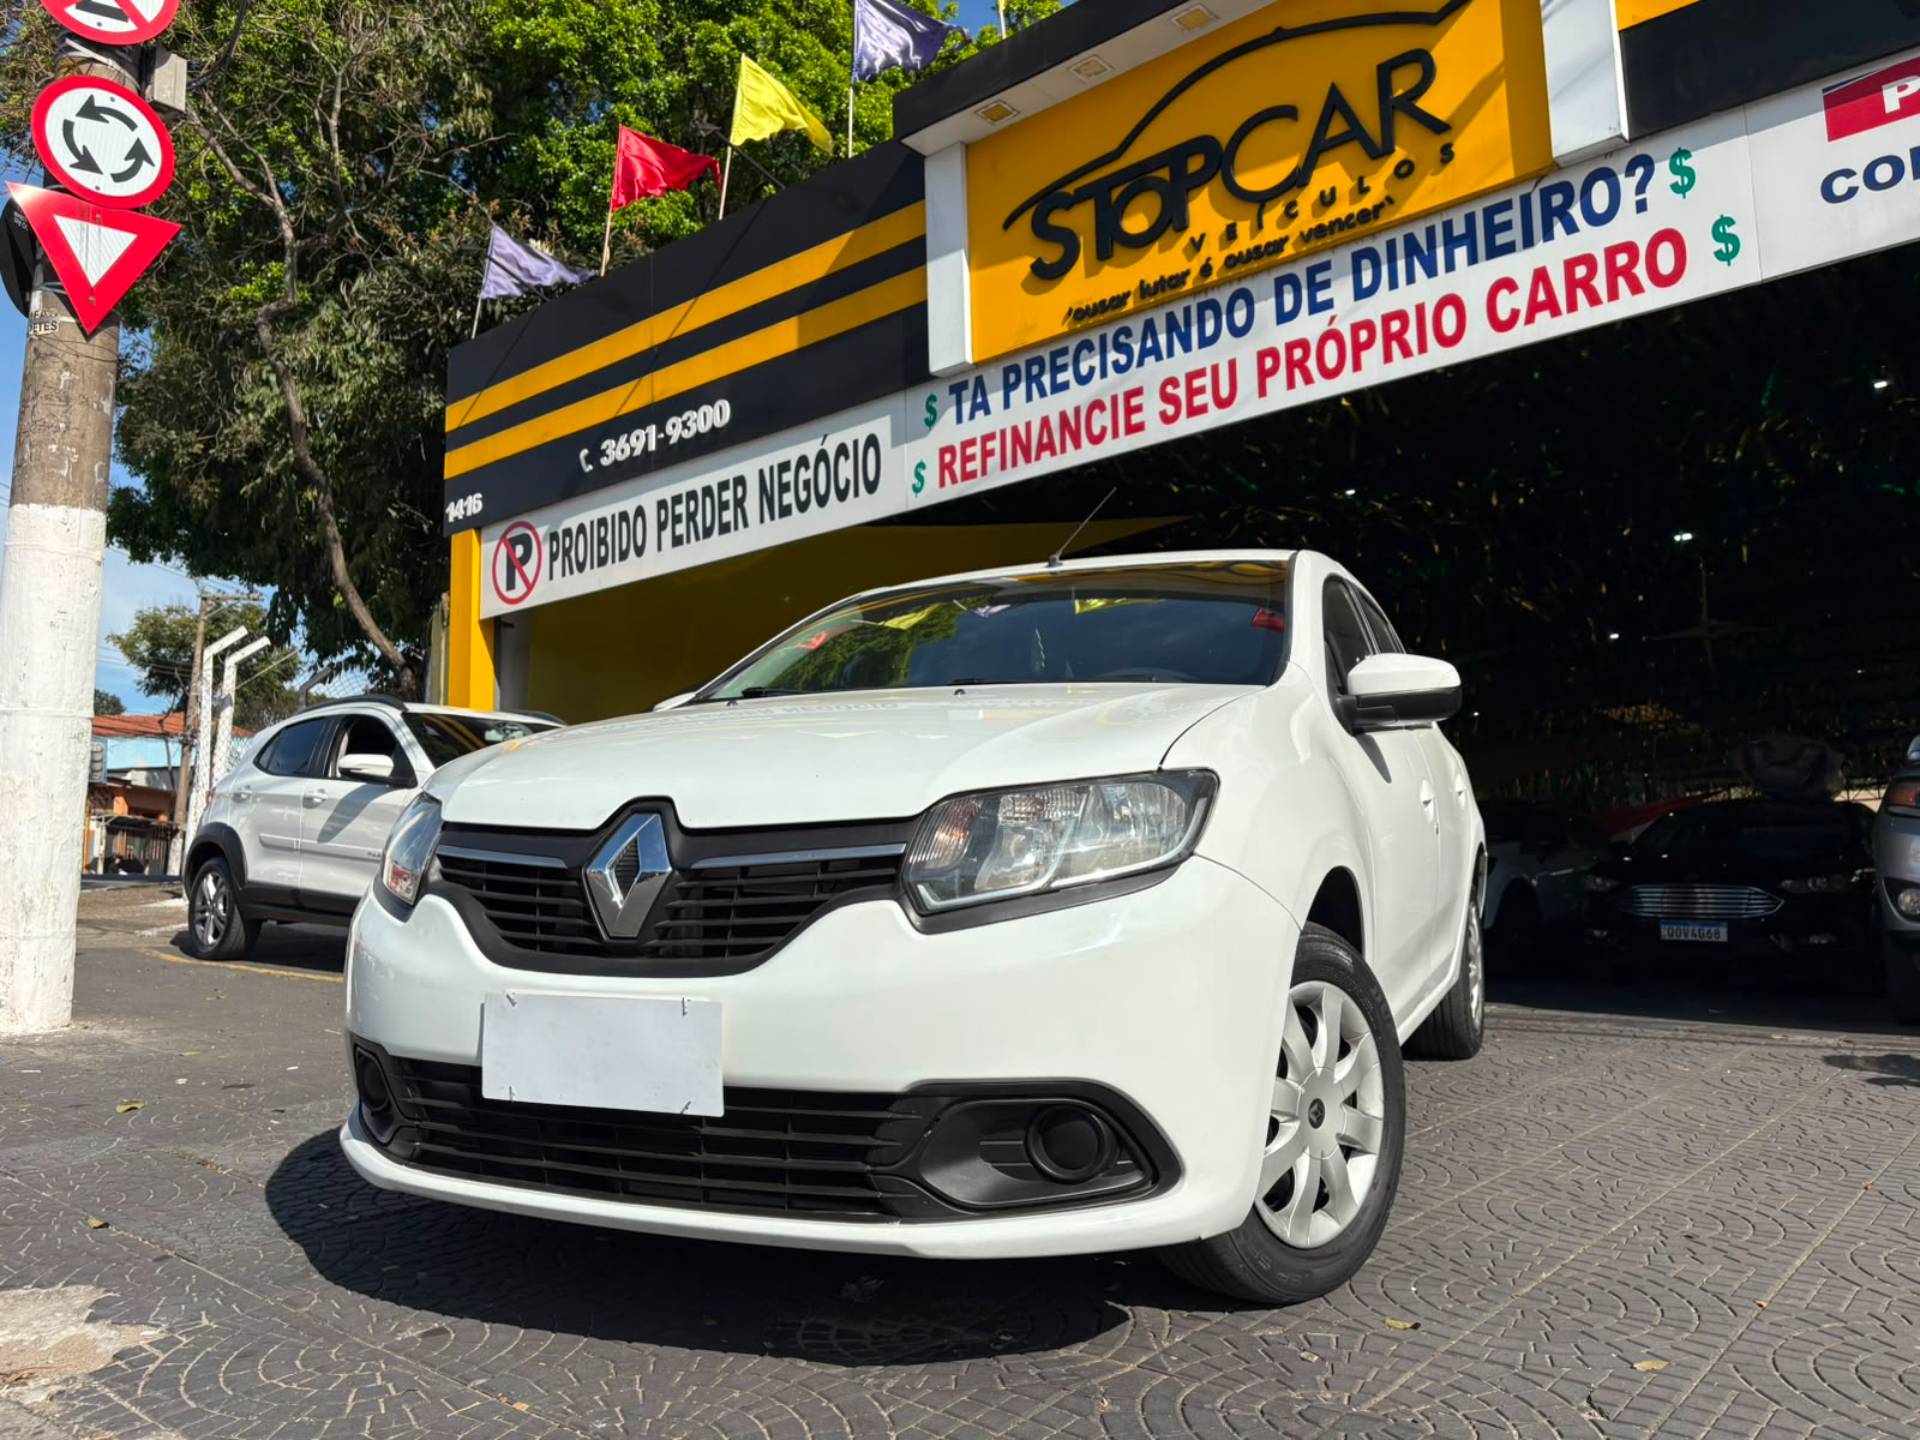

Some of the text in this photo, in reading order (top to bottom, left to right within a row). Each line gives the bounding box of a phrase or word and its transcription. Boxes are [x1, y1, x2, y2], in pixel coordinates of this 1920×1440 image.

[1820, 145, 1920, 204] CO
[924, 147, 1697, 429] $ TA PRECISANDO DE DINHEIRO? $
[1139, 269, 1190, 300] lutar
[1200, 257, 1213, 278] é
[1224, 234, 1289, 270] ousar
[911, 214, 1741, 498] $ REFINANCIE SEU PRÓPRIO CARRO $
[600, 398, 732, 467] 3691-9300
[445, 492, 483, 523] 1416
[548, 503, 648, 582] PROIBIDO
[656, 474, 749, 552] PERDER
[758, 432, 881, 524] NEGÓCIO
